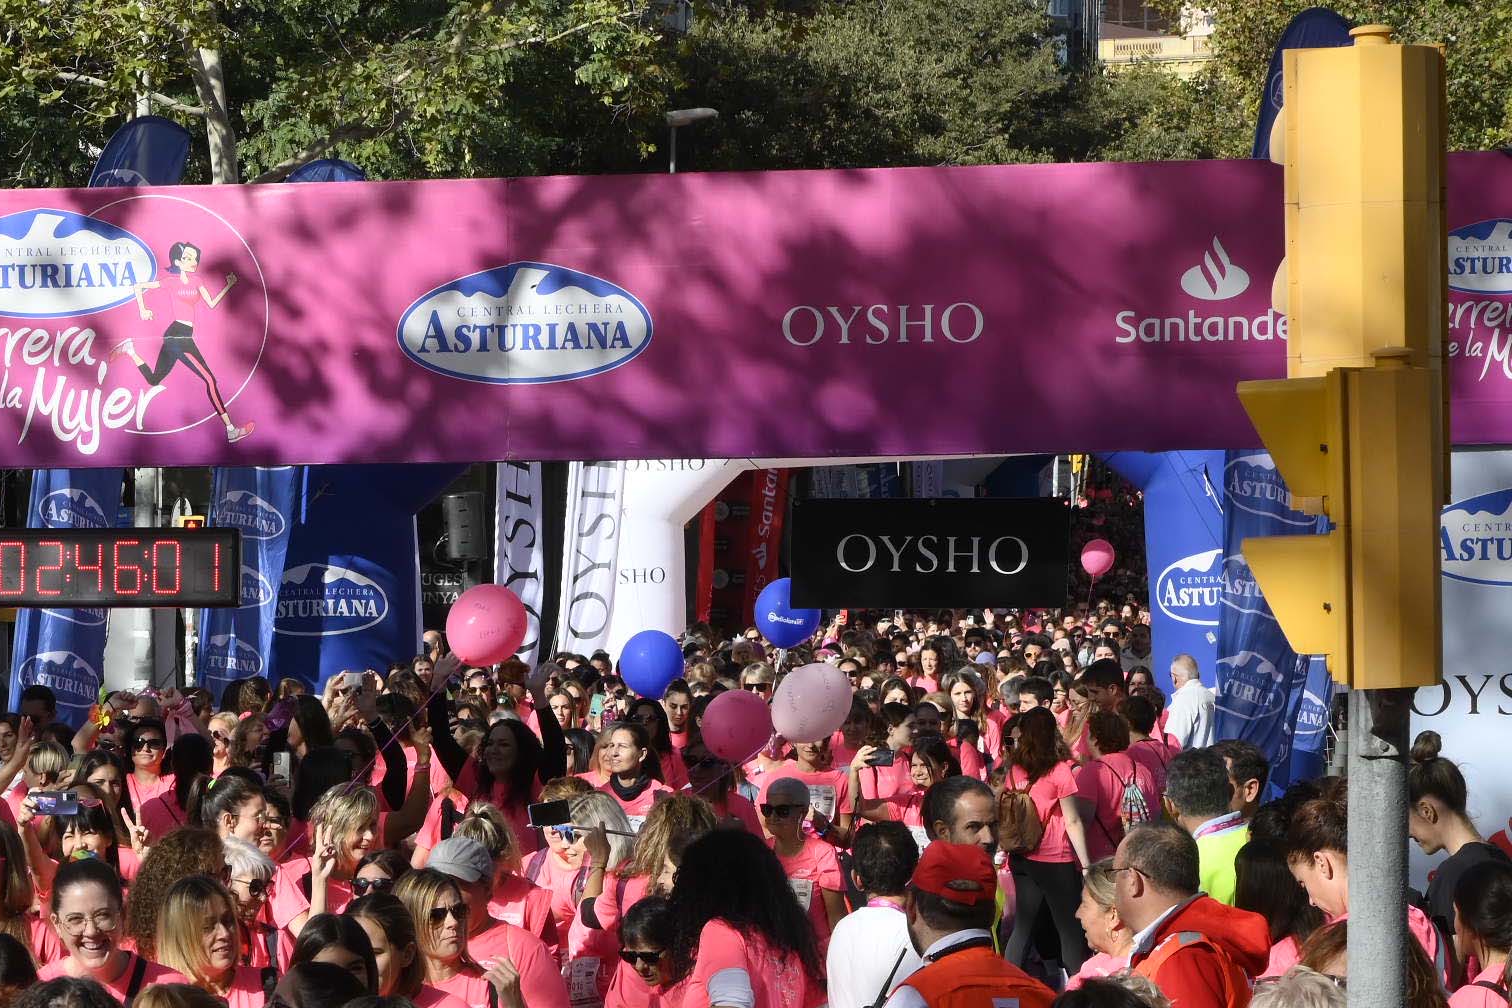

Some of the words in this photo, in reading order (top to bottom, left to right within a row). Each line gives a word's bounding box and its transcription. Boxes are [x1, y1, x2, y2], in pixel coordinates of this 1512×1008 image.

[59, 245, 132, 256] LECHERA
[1455, 244, 1507, 253] CENTRAL
[456, 303, 536, 318] CENTRAL
[543, 302, 625, 315] LECHERA
[417, 309, 633, 354] ASTURIANA
[781, 303, 985, 346] OYSHO
[18, 358, 167, 455] Mujer
[836, 533, 1029, 575] OYSHO
[618, 566, 666, 585] SHO
[1180, 576, 1222, 584] CENTRA
[324, 588, 375, 597] LECHERA
[275, 598, 378, 619] STURIANA
